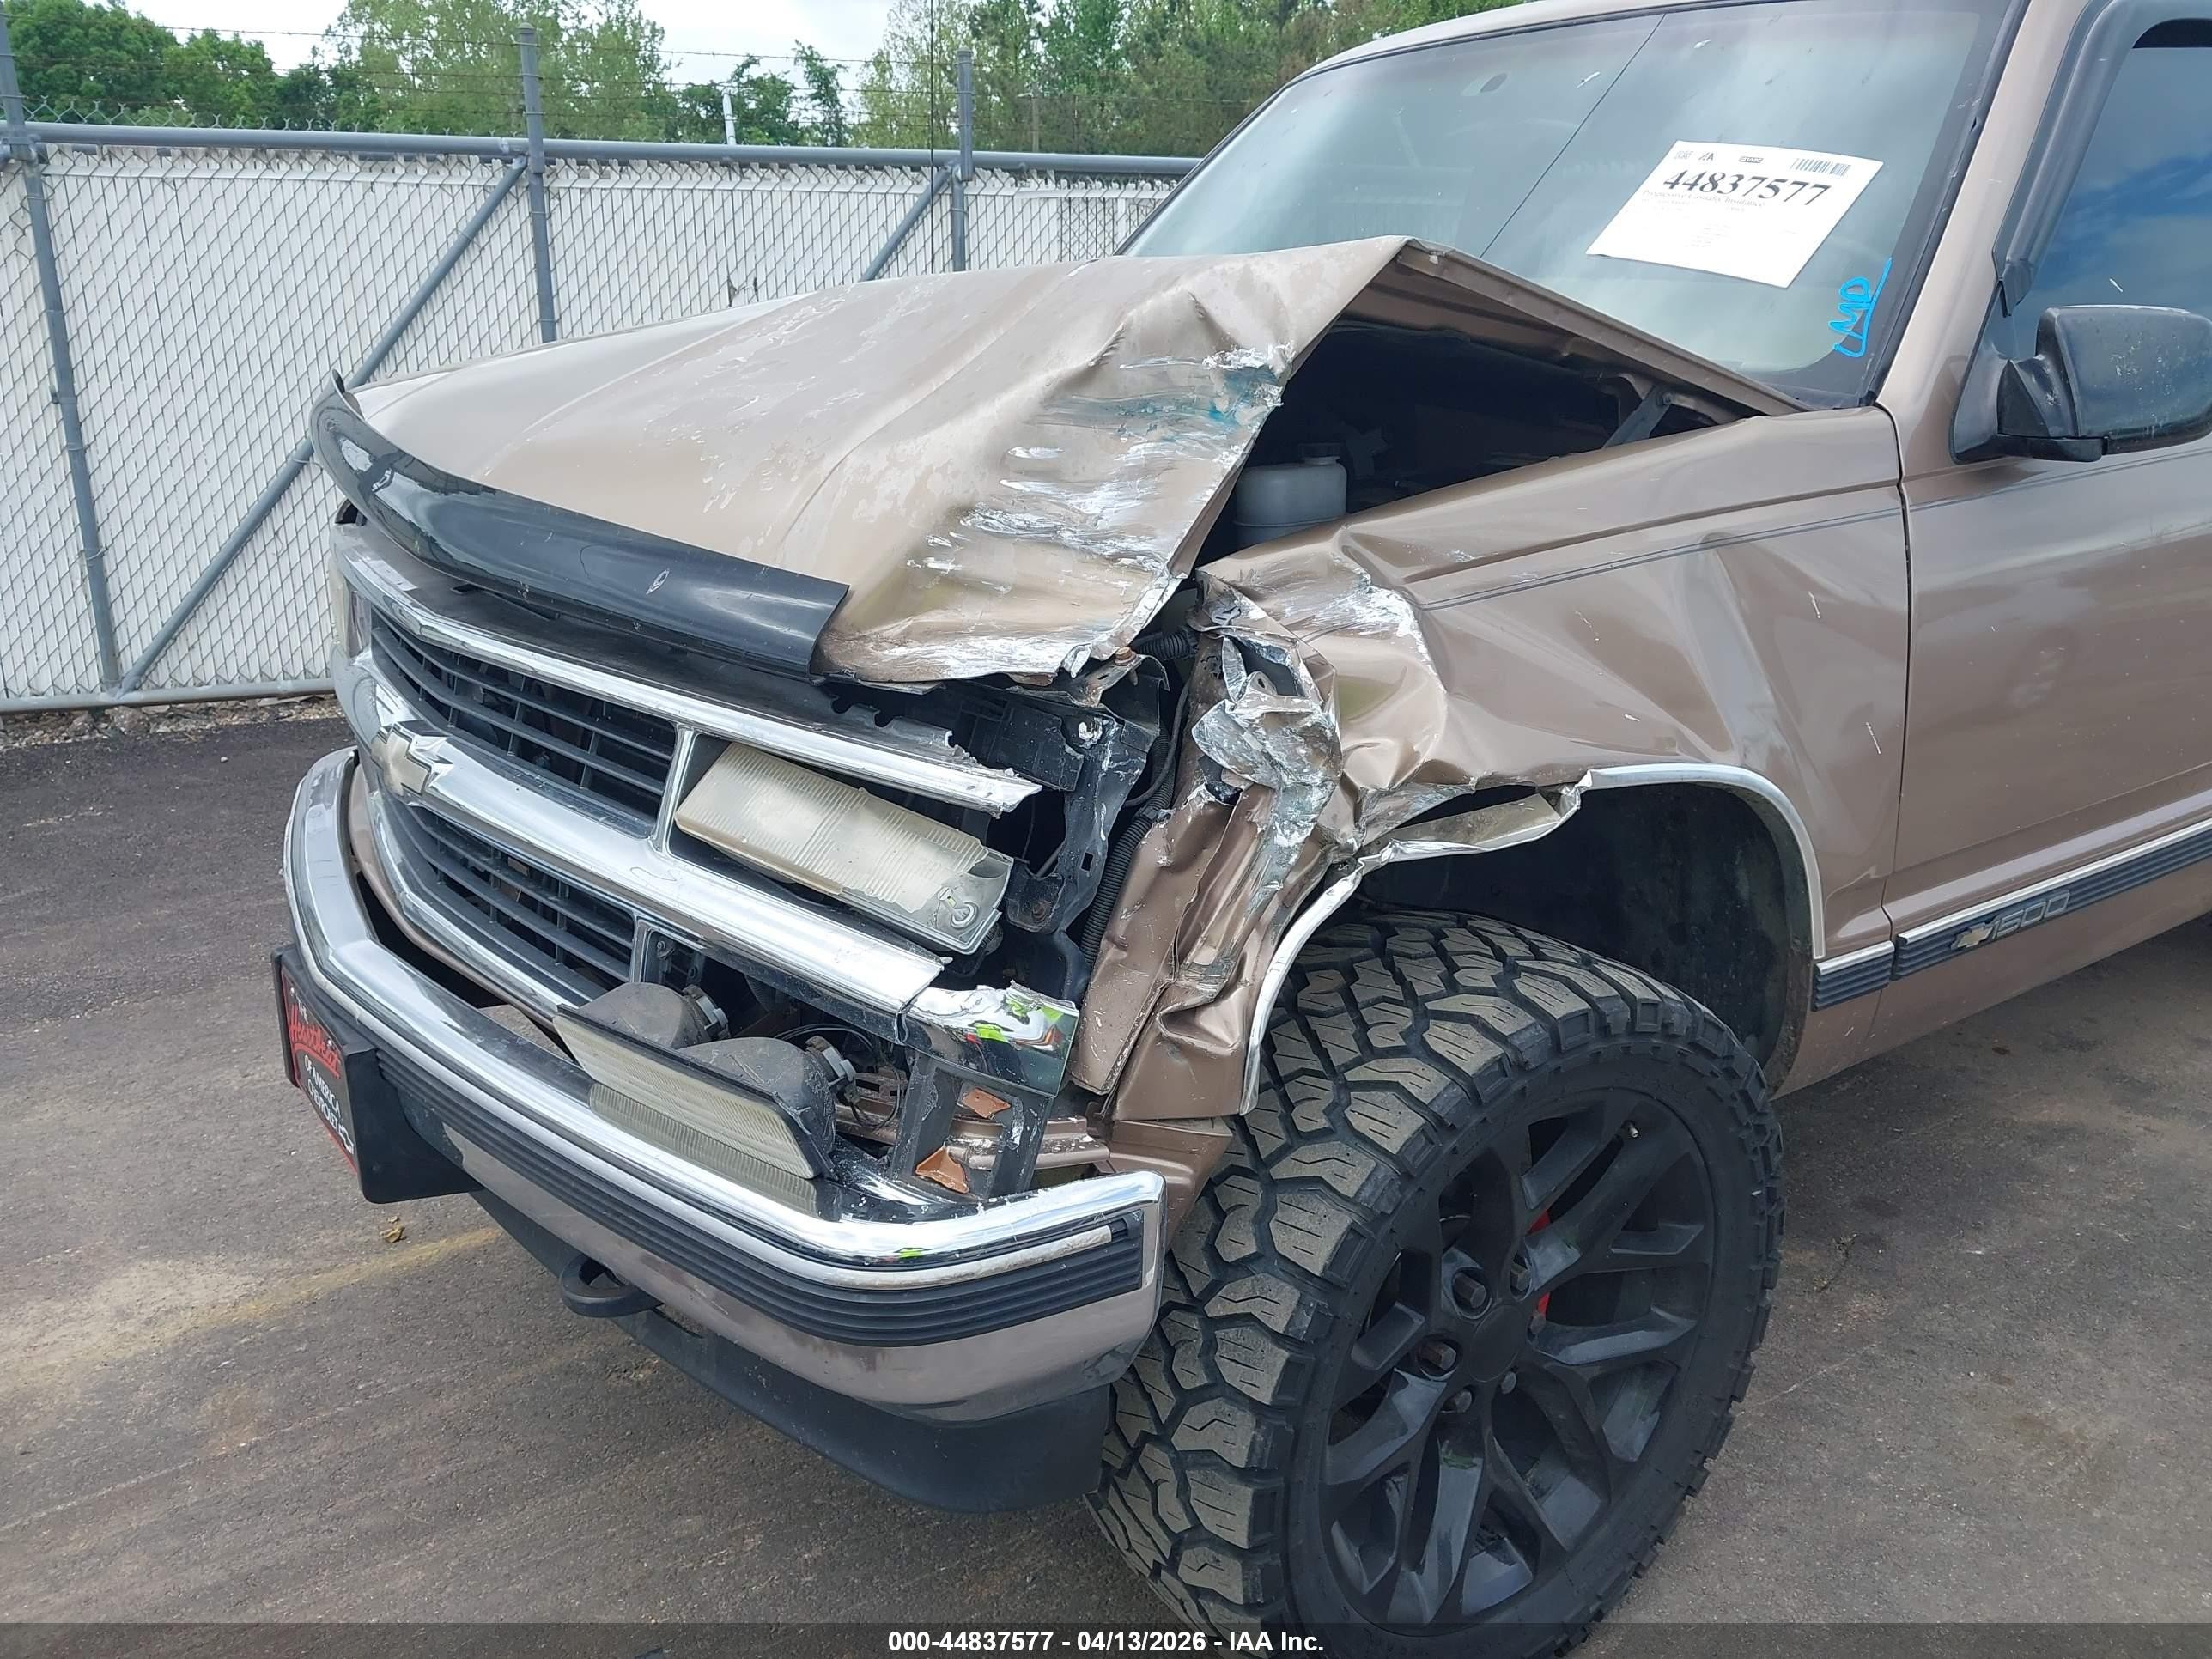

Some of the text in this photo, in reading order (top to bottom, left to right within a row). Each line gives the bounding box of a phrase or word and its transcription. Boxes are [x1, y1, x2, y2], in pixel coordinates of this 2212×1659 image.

[1662, 169, 1833, 206] 44837577
[1991, 890, 2070, 939] 1500
[295, 992, 309, 1024] THE
[304, 1054, 341, 1120] OF AMERICA
[307, 1079, 338, 1133] CHEVROLET
